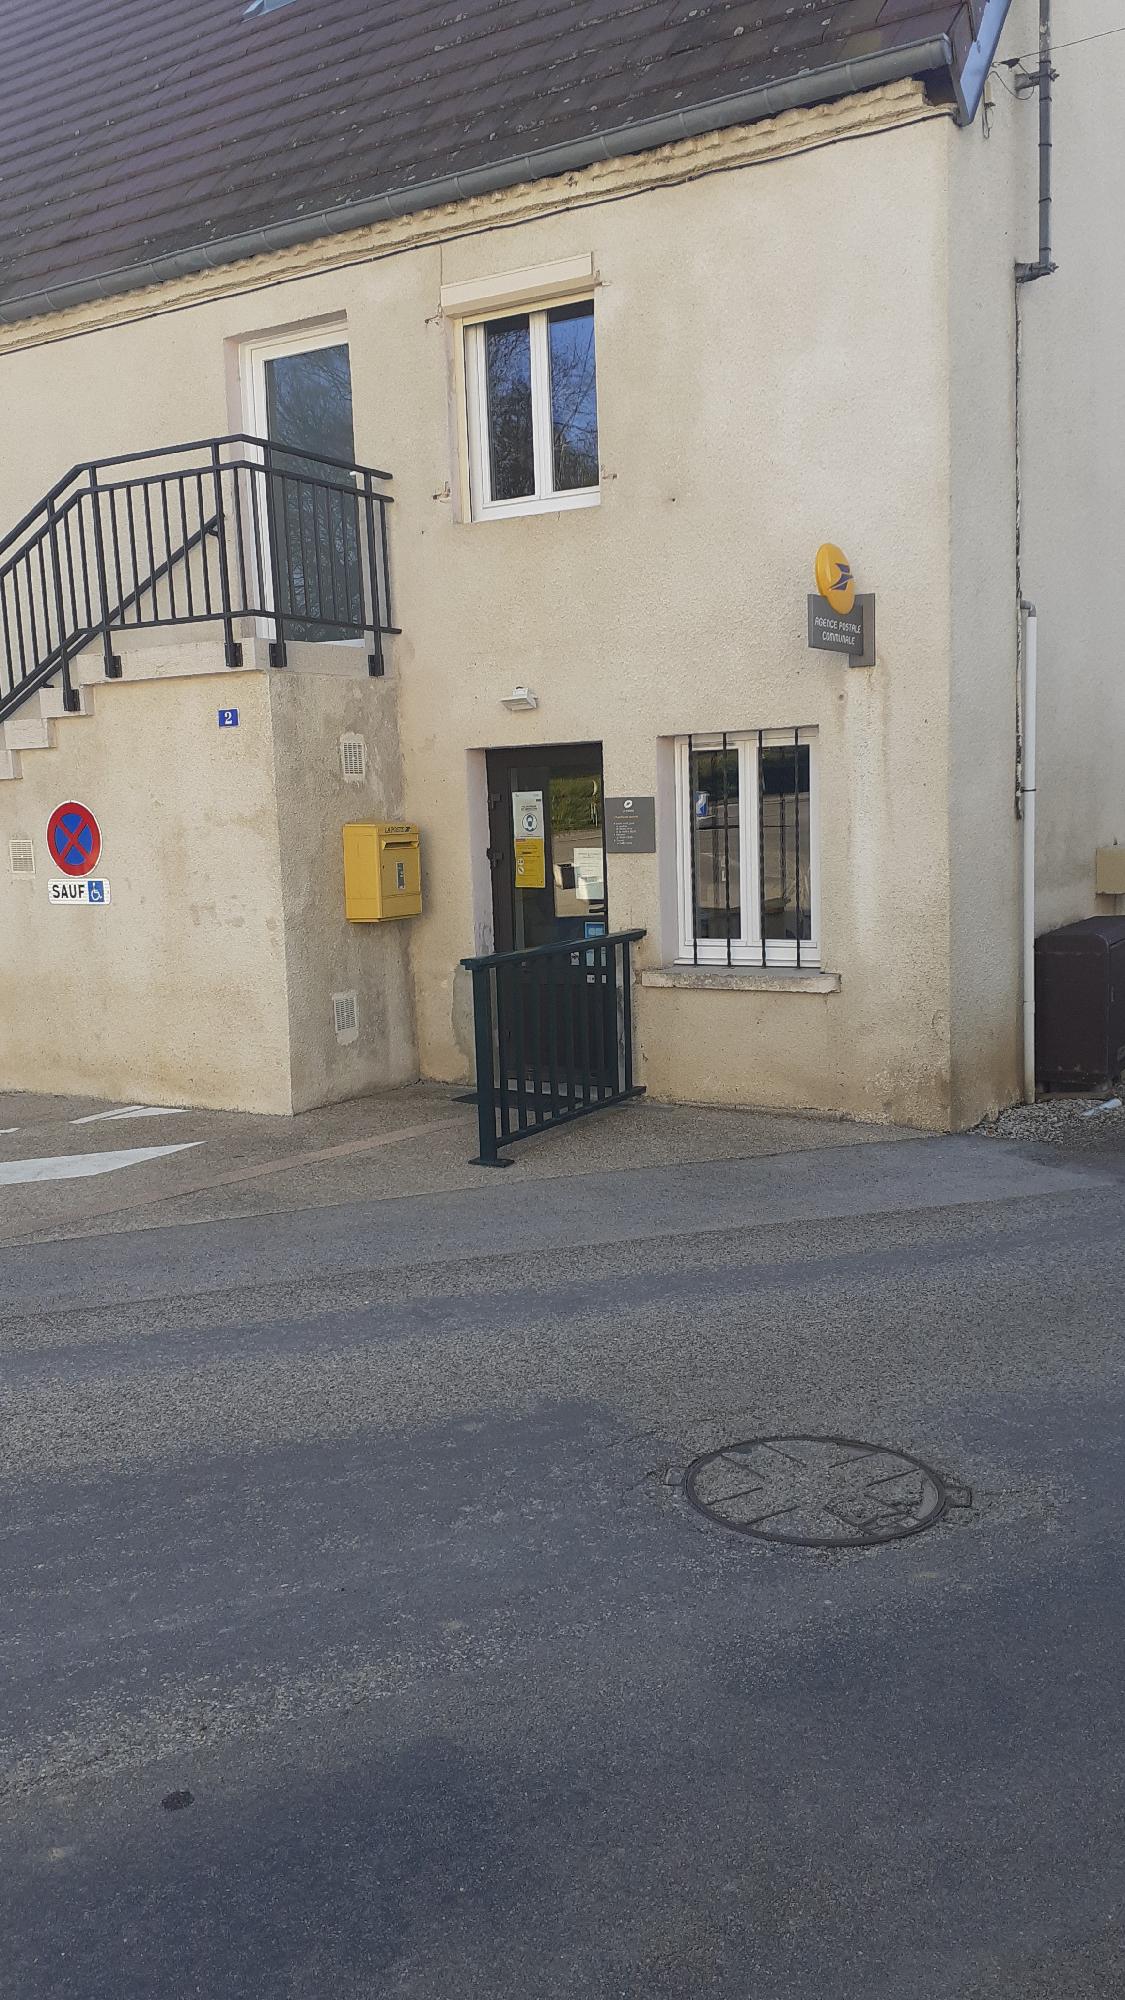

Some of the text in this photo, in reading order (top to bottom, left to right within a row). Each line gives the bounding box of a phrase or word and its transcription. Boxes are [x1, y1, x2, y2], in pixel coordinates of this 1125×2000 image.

[814, 616, 861, 634] AGENCE POSTALE
[822, 631, 855, 645] COMMUNALE
[224, 711, 233, 725] 2
[52, 884, 85, 899] SAUF
